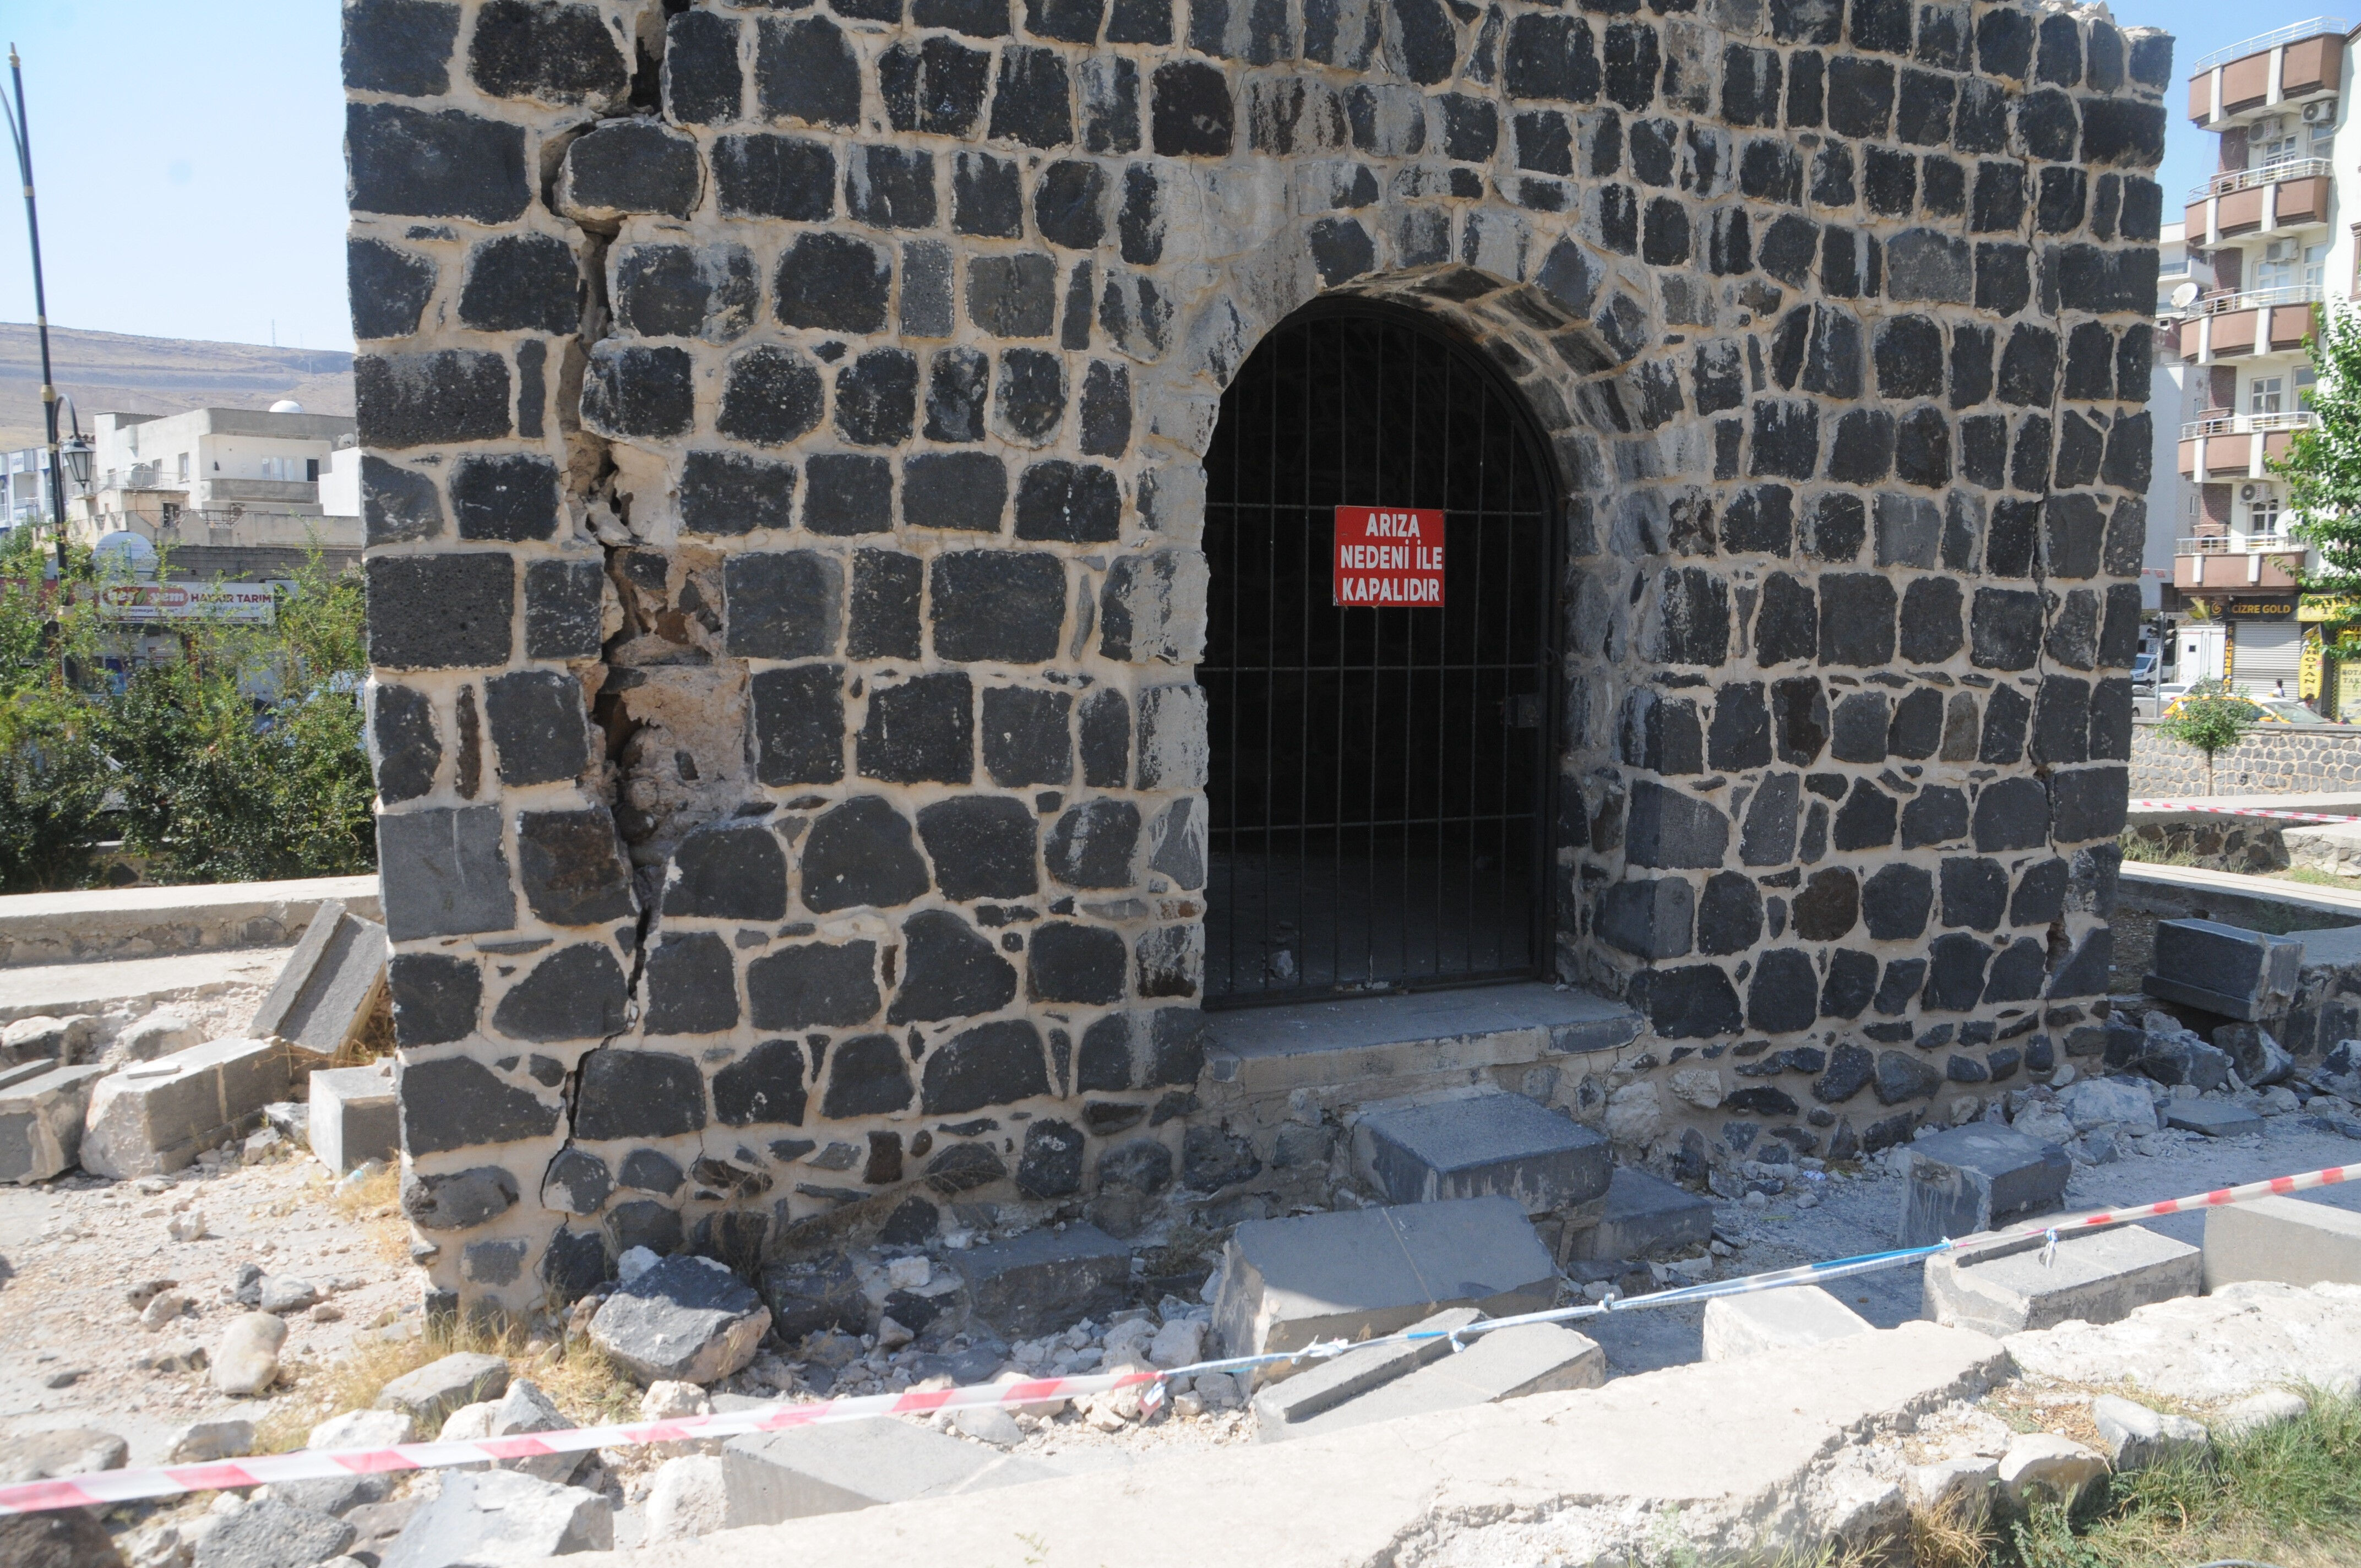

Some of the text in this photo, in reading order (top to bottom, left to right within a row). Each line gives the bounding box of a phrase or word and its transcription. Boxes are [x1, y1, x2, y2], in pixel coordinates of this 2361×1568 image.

[1366, 513, 1420, 537] ARIZA
[1341, 539, 1443, 569] NEDENİ İLE
[237, 594, 271, 603] TARIM
[1342, 578, 1439, 601] KAPALIDIR
[2232, 603, 2291, 613] CİZRE GOLD
